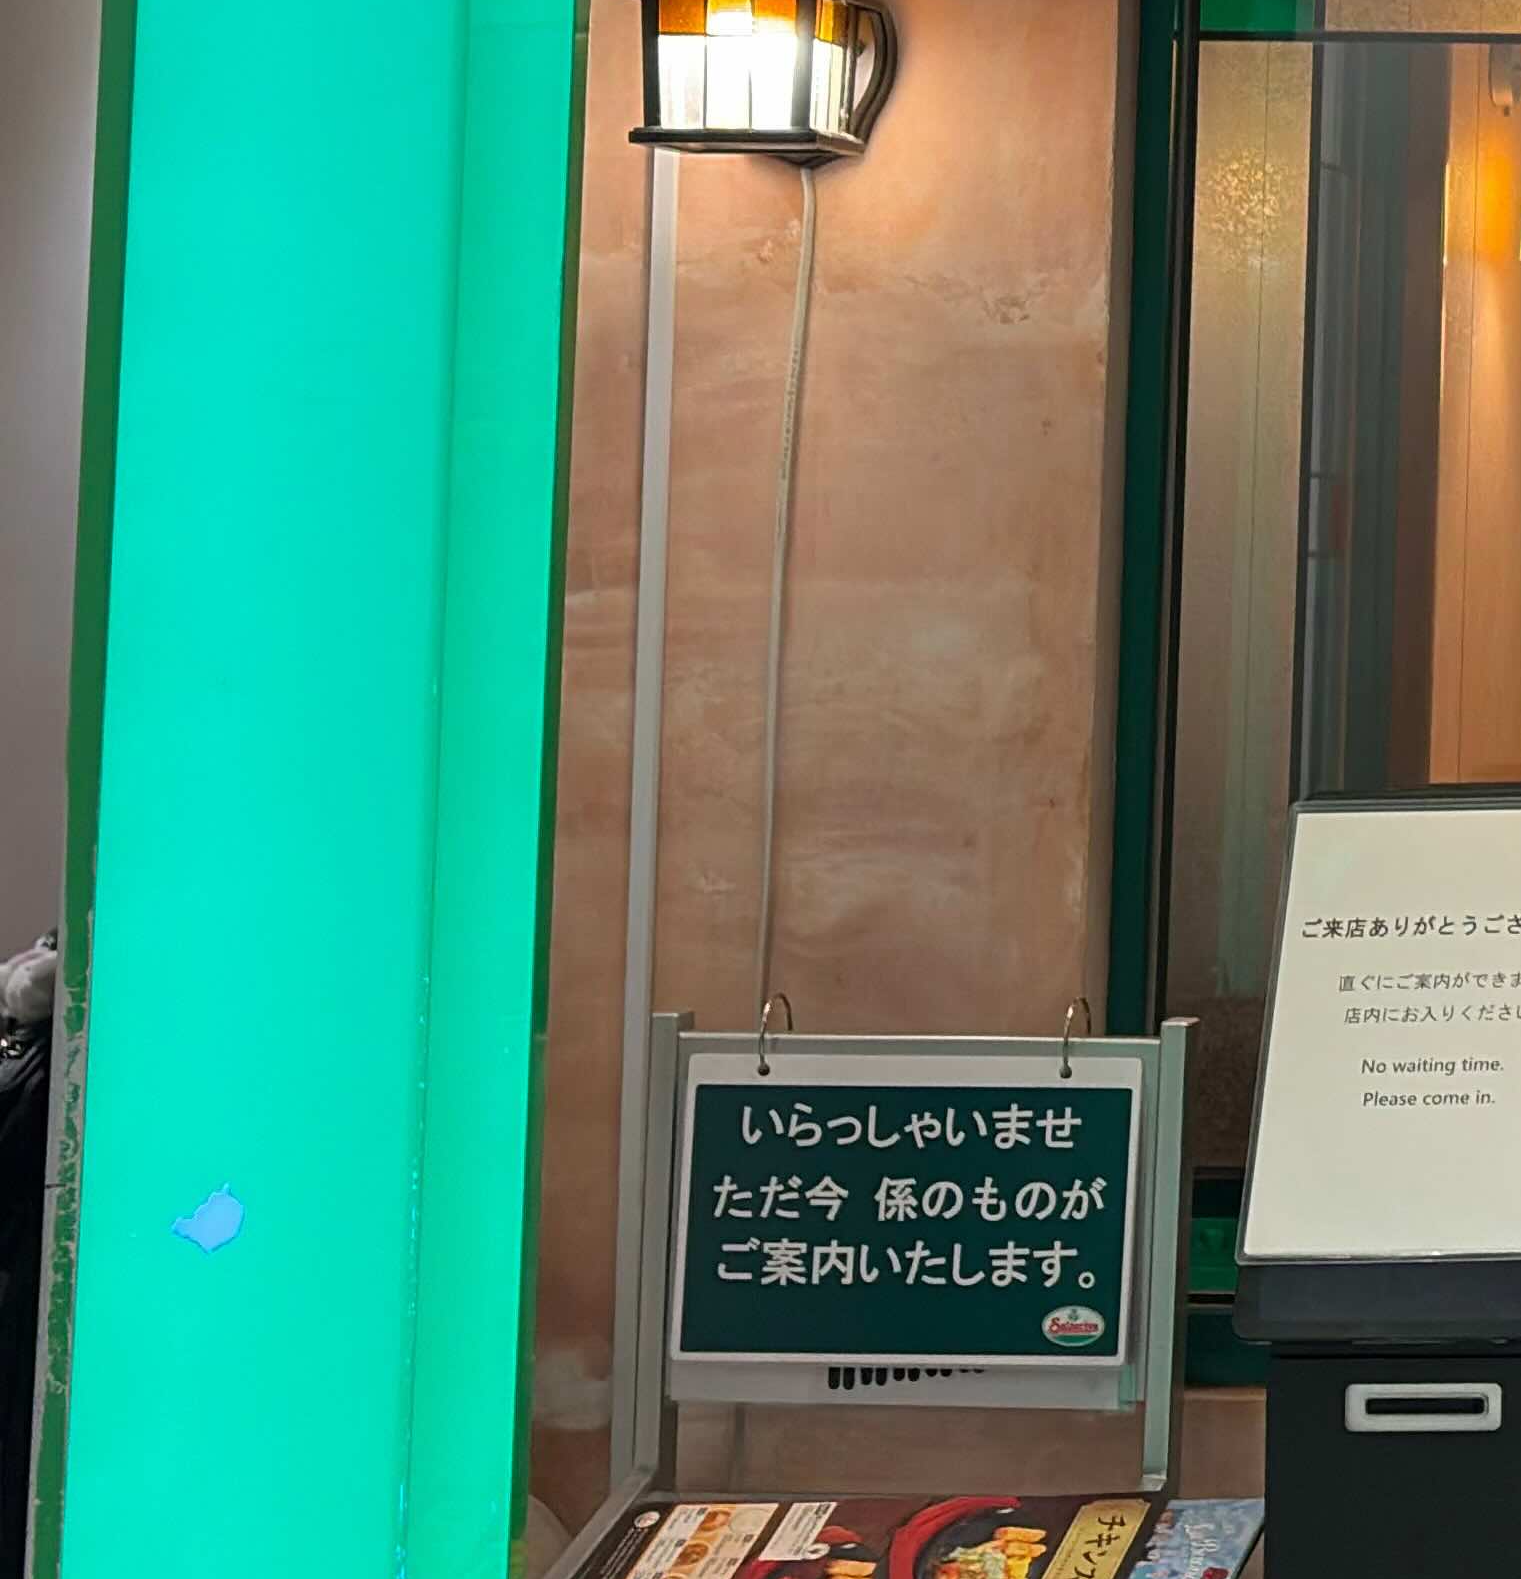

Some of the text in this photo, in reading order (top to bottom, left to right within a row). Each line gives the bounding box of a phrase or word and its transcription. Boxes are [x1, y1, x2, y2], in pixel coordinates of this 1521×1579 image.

[1361, 1056, 1504, 1077] No waiting time.
[1362, 1089, 1496, 1107] Please come in.
[741, 1102, 1083, 1151] いらっしゃいませ
[711, 1175, 1108, 1222] ただ今 係のものが
[715, 1237, 1097, 1290] ご案内いたします。
